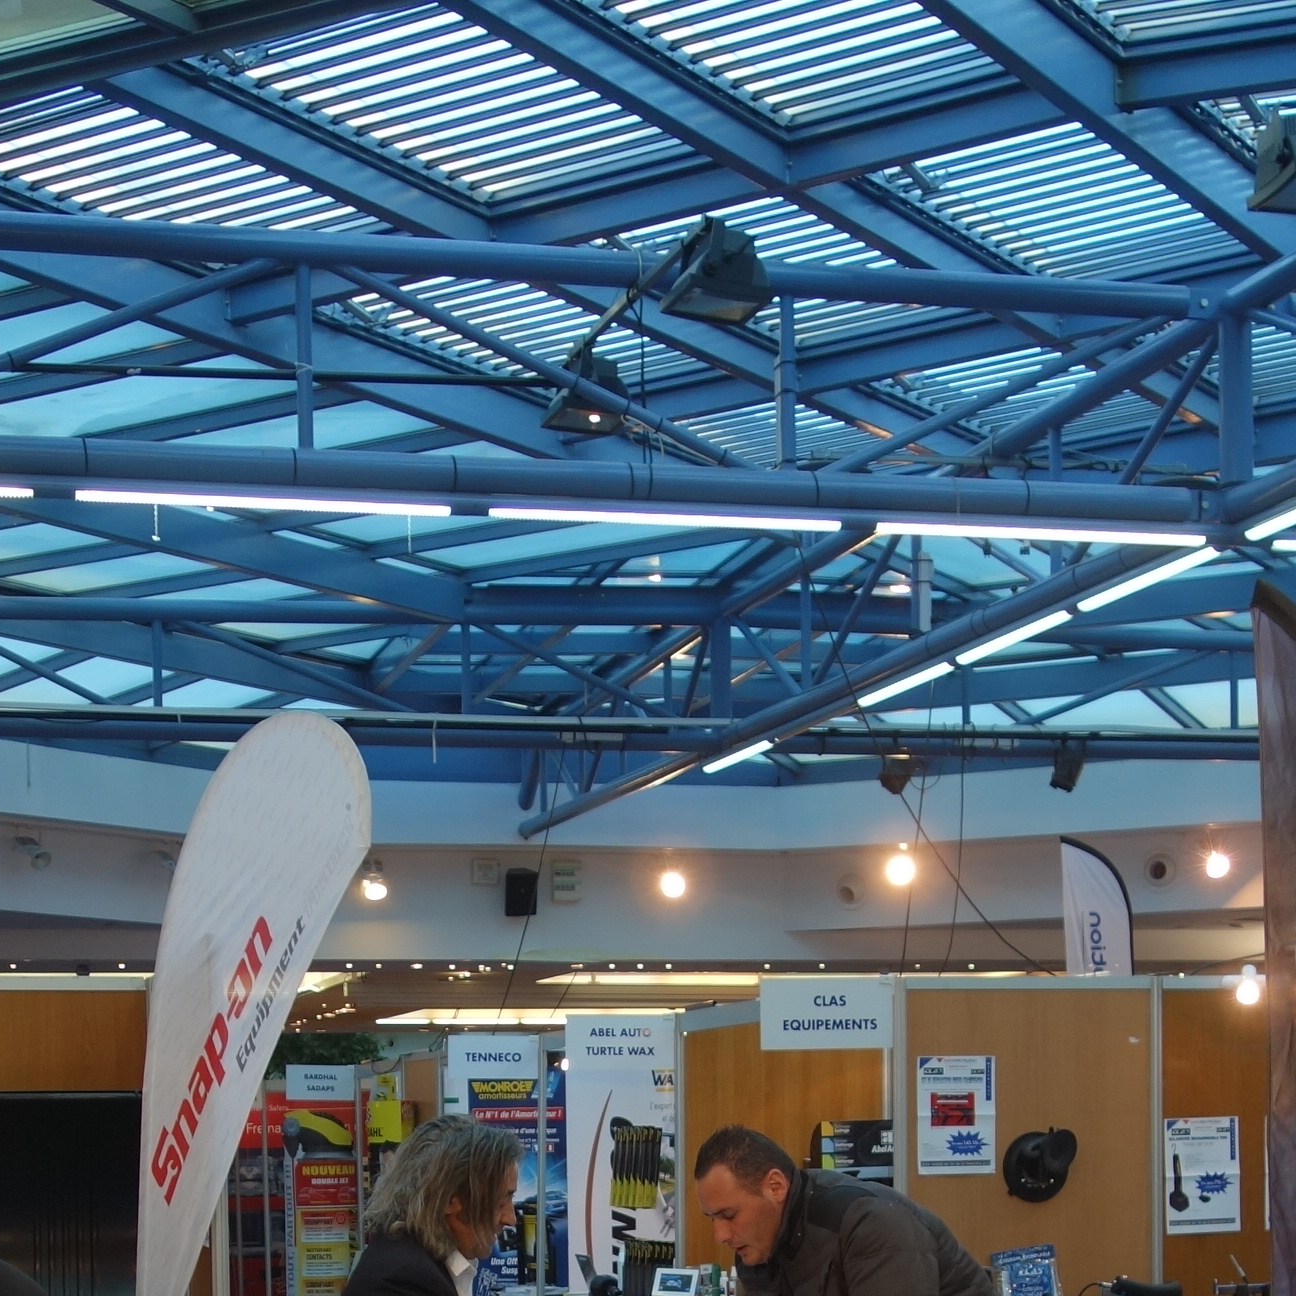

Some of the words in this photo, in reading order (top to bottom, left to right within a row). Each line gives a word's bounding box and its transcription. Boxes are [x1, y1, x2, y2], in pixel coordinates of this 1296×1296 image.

[235, 914, 306, 1074] Equipment
[813, 995, 847, 1007] CLAS
[782, 1017, 878, 1033] EQUIPEMENTS
[590, 1027, 616, 1037] ABEL
[620, 1027, 652, 1038] AUTO
[585, 1046, 624, 1056] TURTLE
[627, 1046, 655, 1056] WAX
[151, 915, 273, 1206] Snap-on
[465, 1052, 522, 1062] TENNECO
[651, 1069, 674, 1087] WA
[478, 1081, 529, 1092] MONROE
[368, 1127, 384, 1137] AHL
[302, 1165, 355, 1176] NOUVEAU
[507, 1257, 518, 1265] Off
